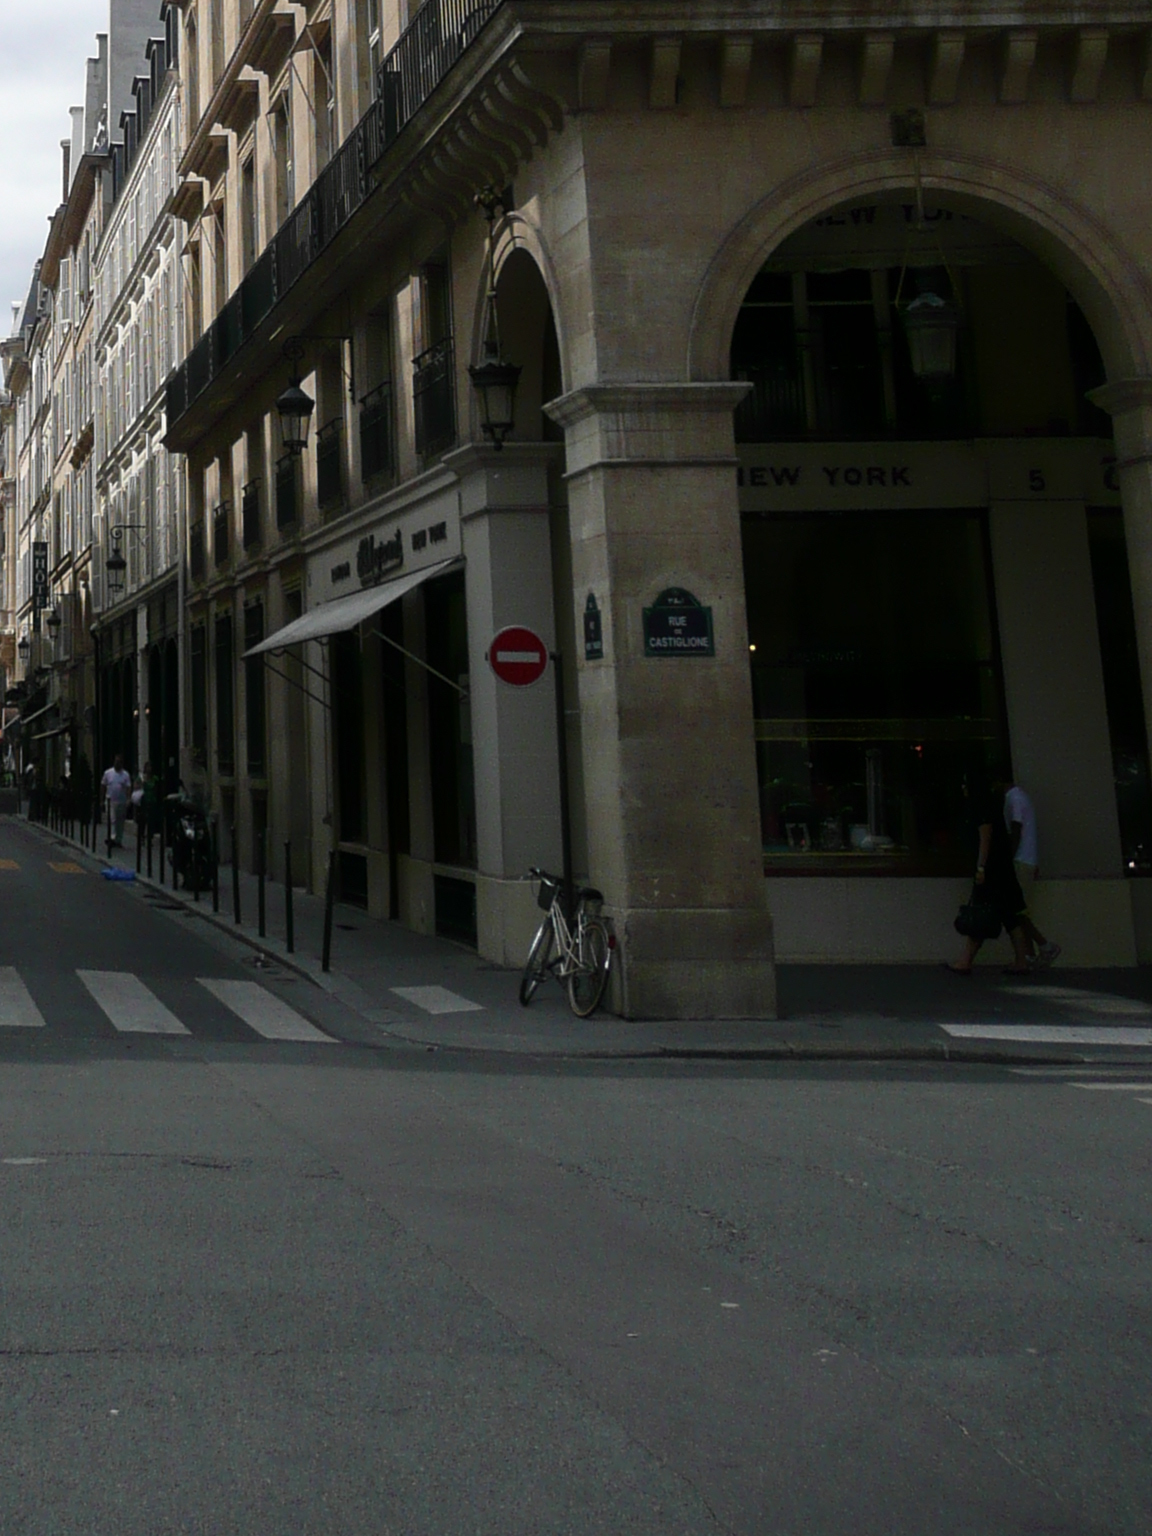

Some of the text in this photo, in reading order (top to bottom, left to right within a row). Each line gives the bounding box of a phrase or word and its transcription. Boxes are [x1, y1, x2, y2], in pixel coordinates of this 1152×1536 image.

[737, 467, 913, 487] EW YORK
[1029, 469, 1046, 492] 5
[668, 616, 687, 627] RUE
[649, 636, 710, 648] CASTIGLIONE
